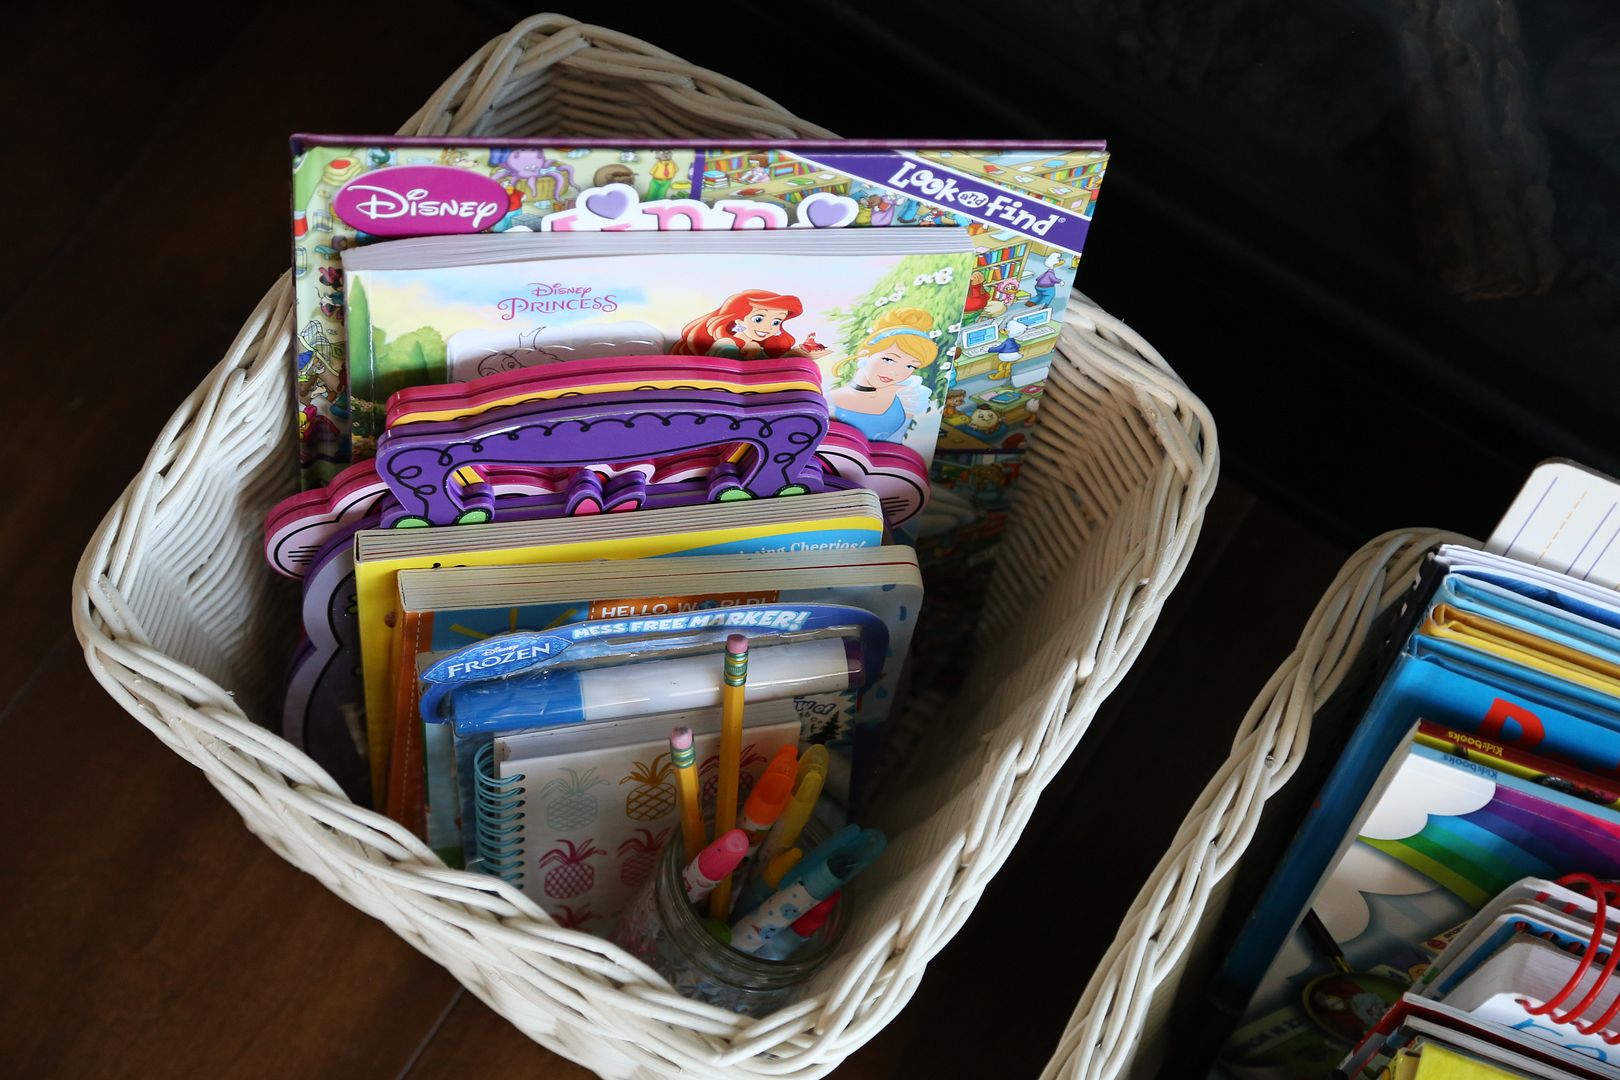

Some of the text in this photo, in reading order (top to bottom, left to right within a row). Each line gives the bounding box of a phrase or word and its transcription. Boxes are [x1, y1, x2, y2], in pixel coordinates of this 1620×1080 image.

[887, 161, 960, 202] Look
[959, 192, 987, 207] and
[574, 610, 809, 639] MESS FREE MARKER!
[447, 642, 550, 678] FROZEN
[1447, 730, 1504, 757] Kidsbooks
[1442, 753, 1498, 780] Kidsbooks
